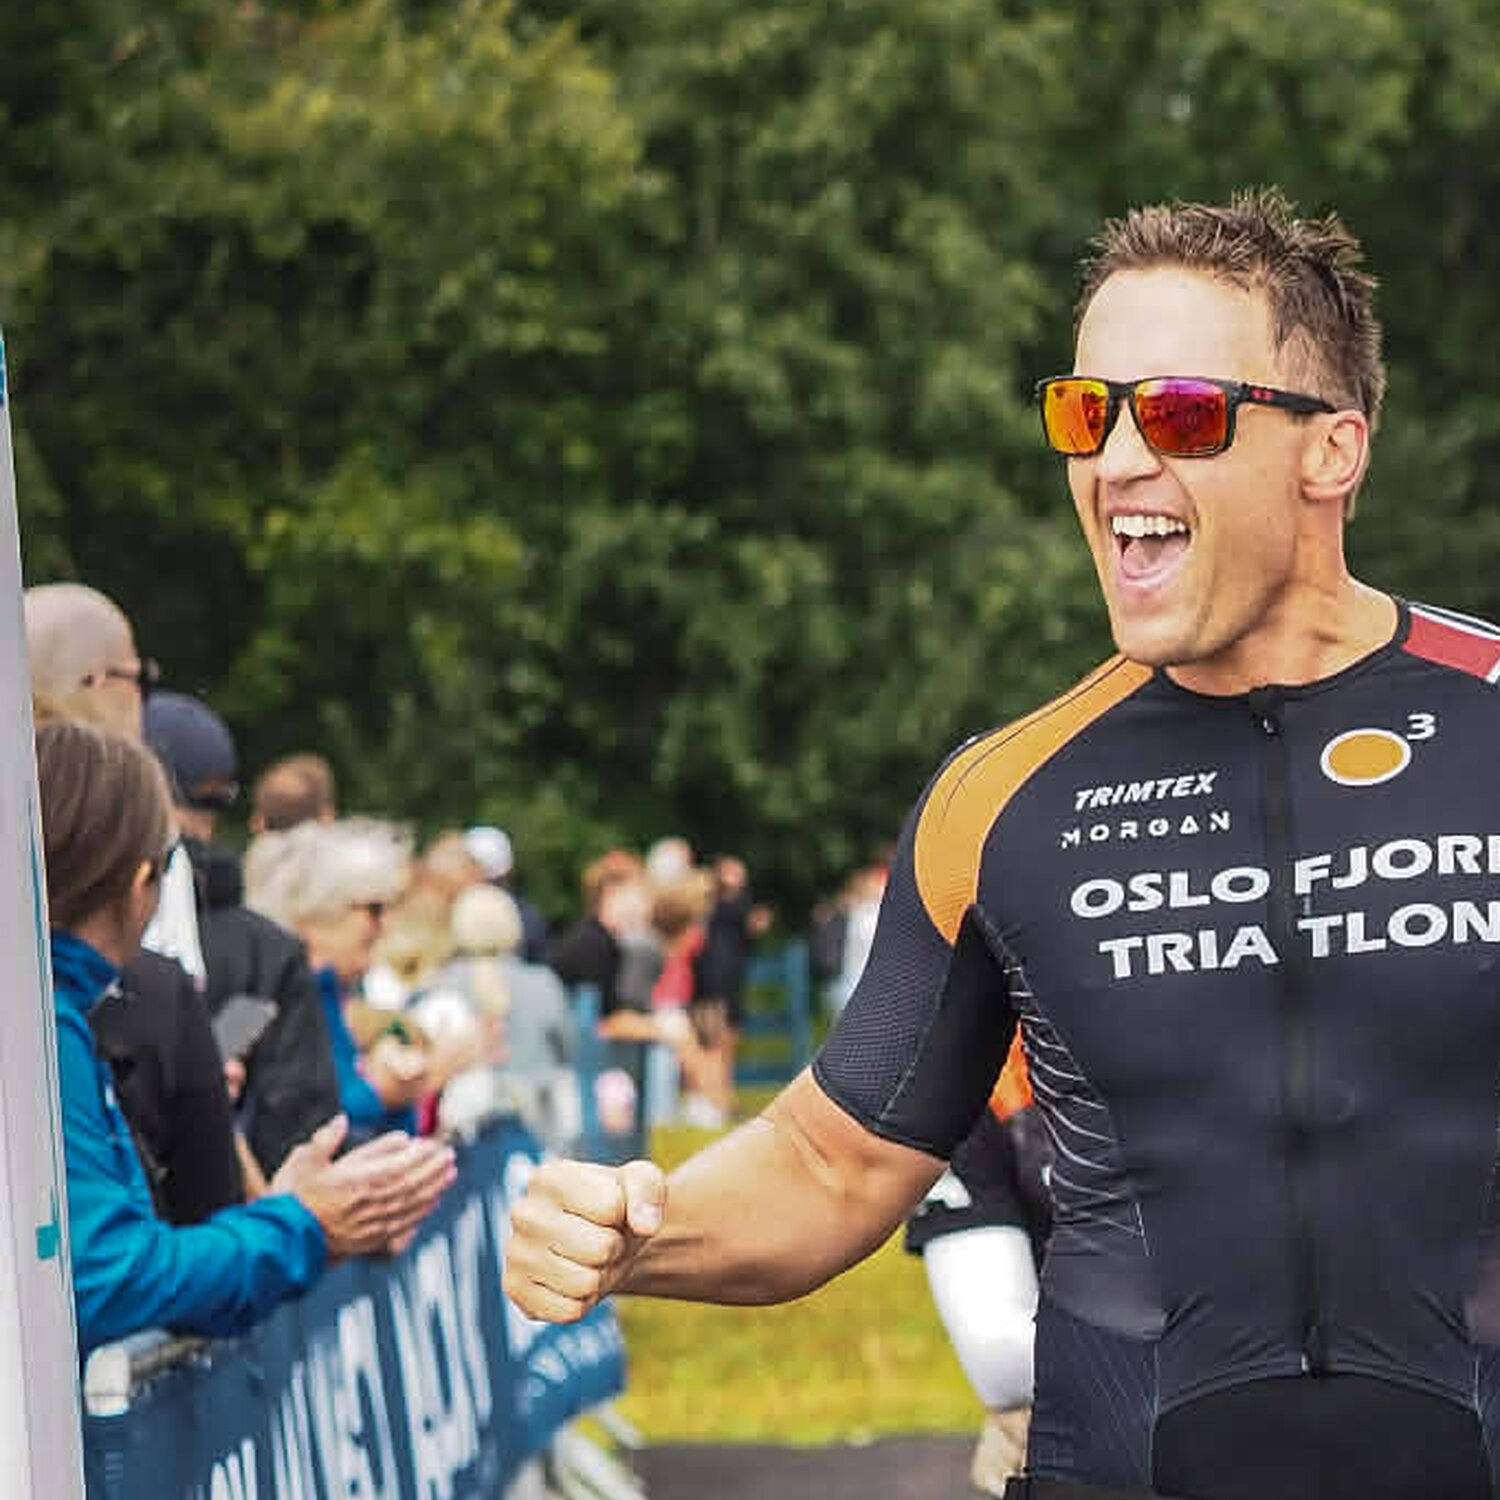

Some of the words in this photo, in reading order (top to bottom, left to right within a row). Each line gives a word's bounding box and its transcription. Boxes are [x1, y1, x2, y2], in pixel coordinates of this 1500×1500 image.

[1074, 771, 1218, 812] TRIMTEX
[1060, 810, 1231, 850] MORGAN
[1070, 866, 1270, 918] OSLO
